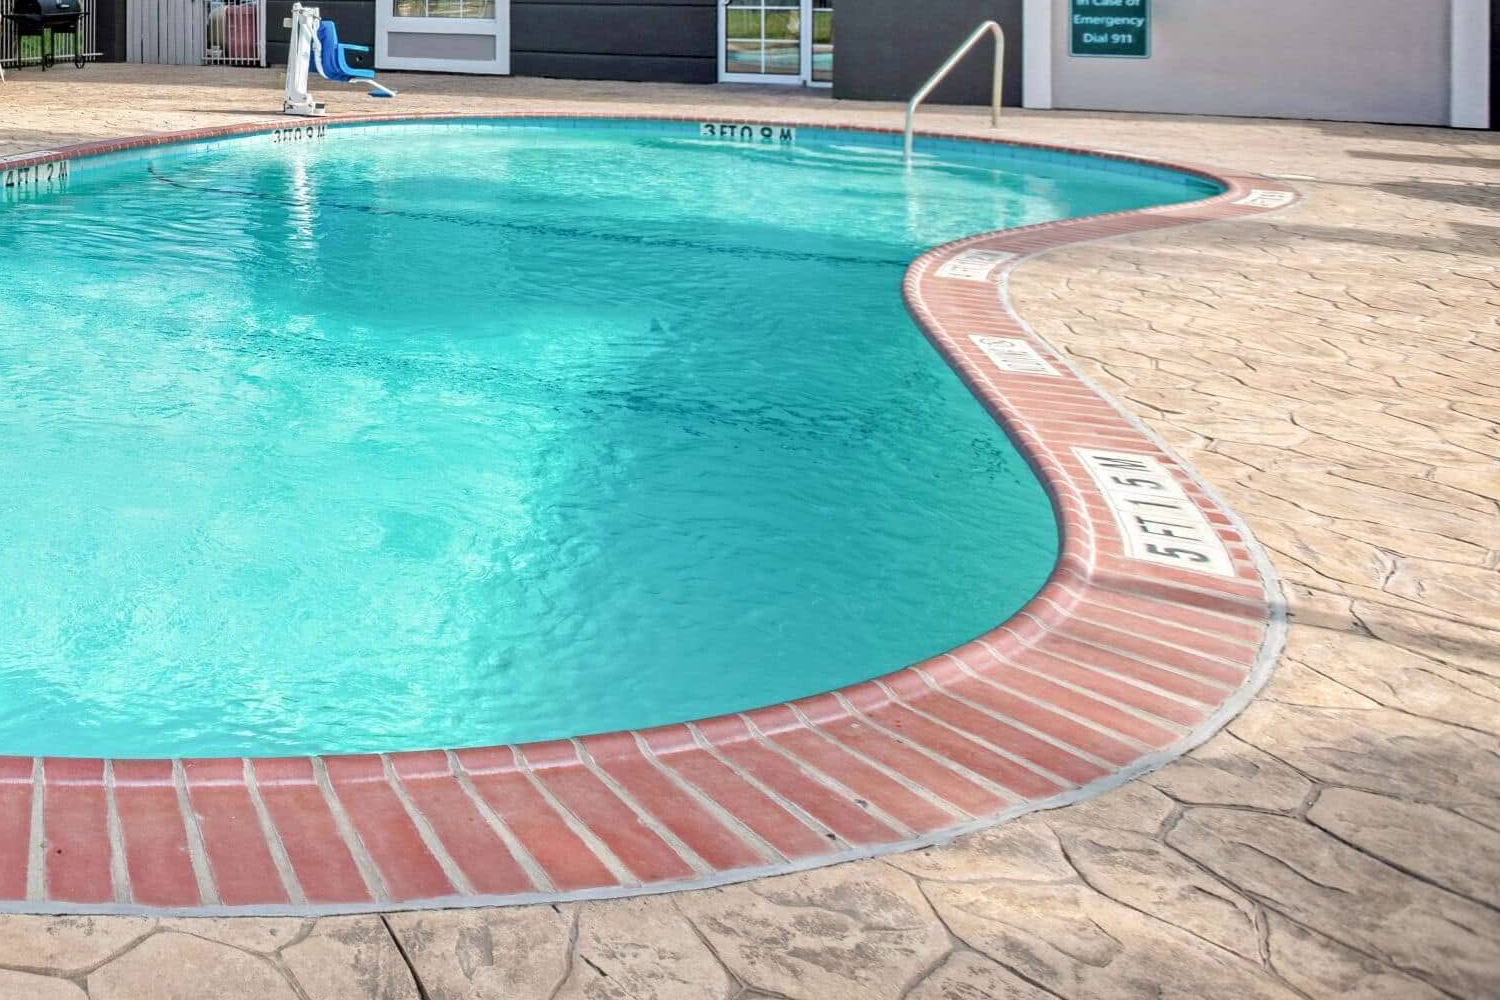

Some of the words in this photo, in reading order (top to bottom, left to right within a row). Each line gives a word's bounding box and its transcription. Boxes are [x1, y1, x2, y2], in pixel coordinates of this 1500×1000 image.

[1074, 14, 1145, 27] Emergency
[1083, 32, 1108, 43] Dial
[1110, 33, 1133, 43] 911
[1092, 455, 1148, 469] M
[1111, 476, 1167, 490] 5
[1134, 515, 1204, 541] FT
[1146, 543, 1210, 563] 5
